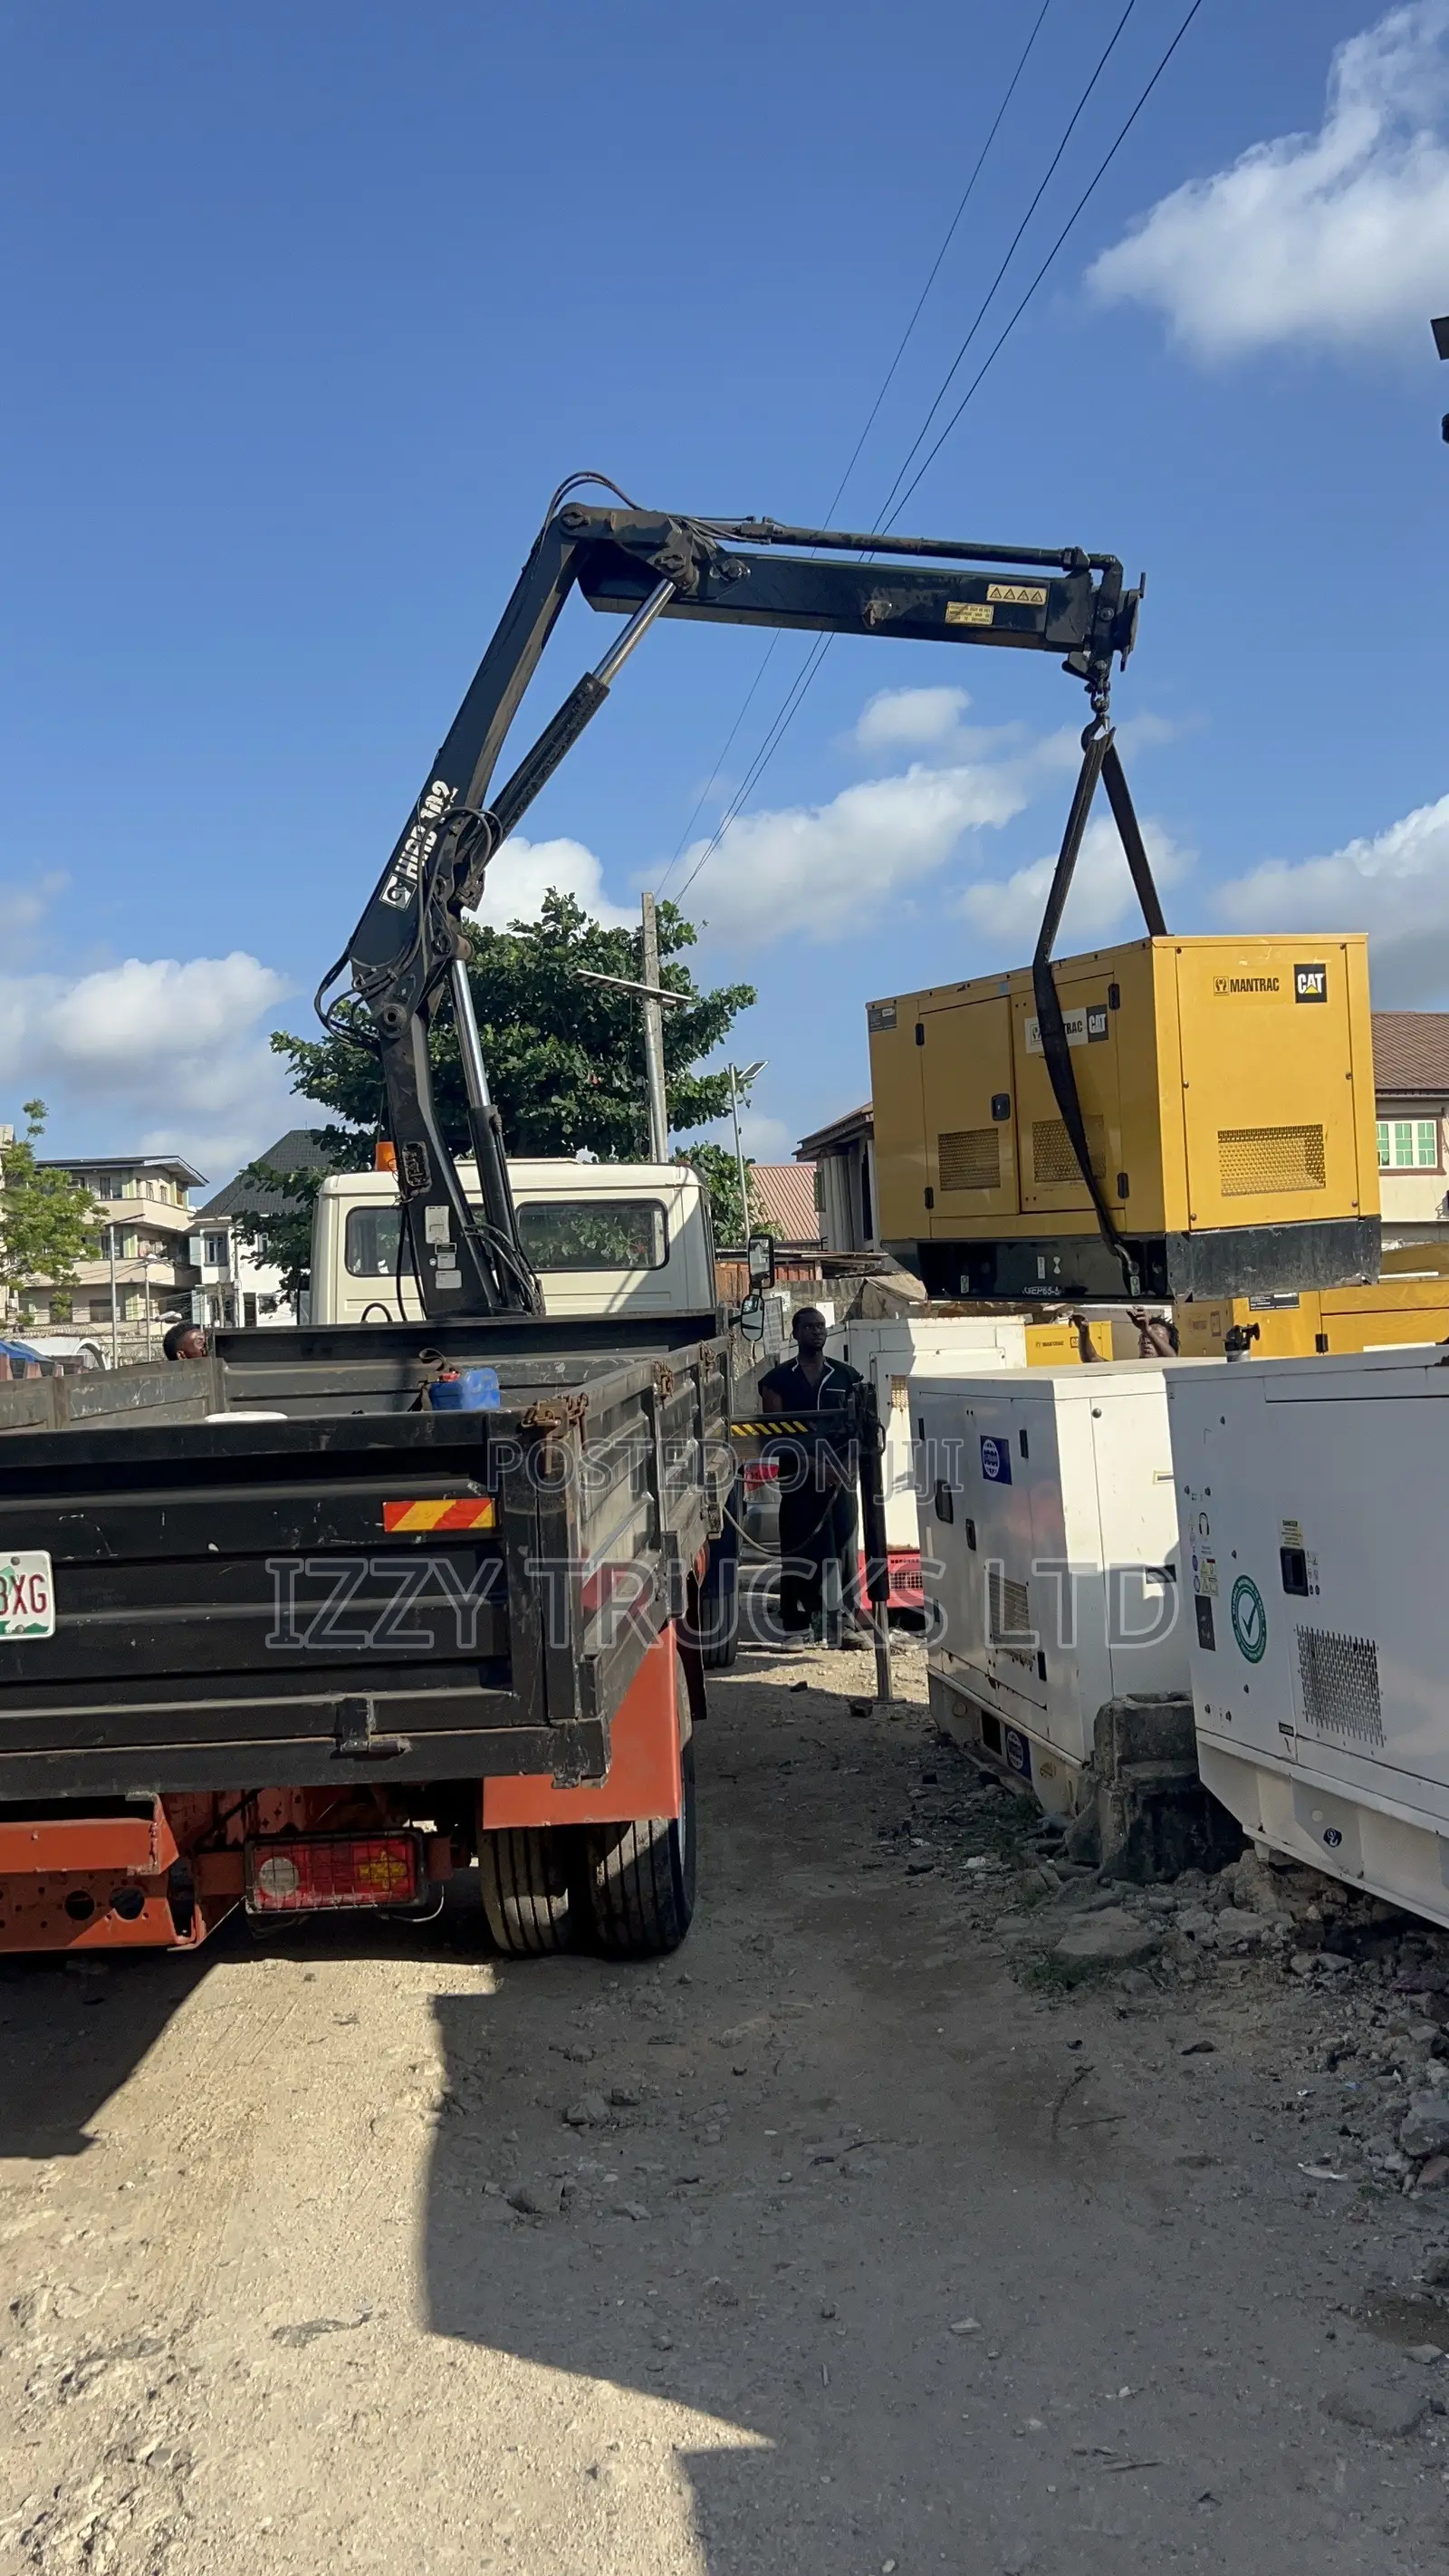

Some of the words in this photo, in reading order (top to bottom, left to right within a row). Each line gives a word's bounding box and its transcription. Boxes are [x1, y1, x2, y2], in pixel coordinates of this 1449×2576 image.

[395, 824, 437, 880] HIAB
[1230, 977, 1280, 993] MANTRAC
[1297, 973, 1325, 995] CAT
[1089, 1014, 1107, 1033] CAT
